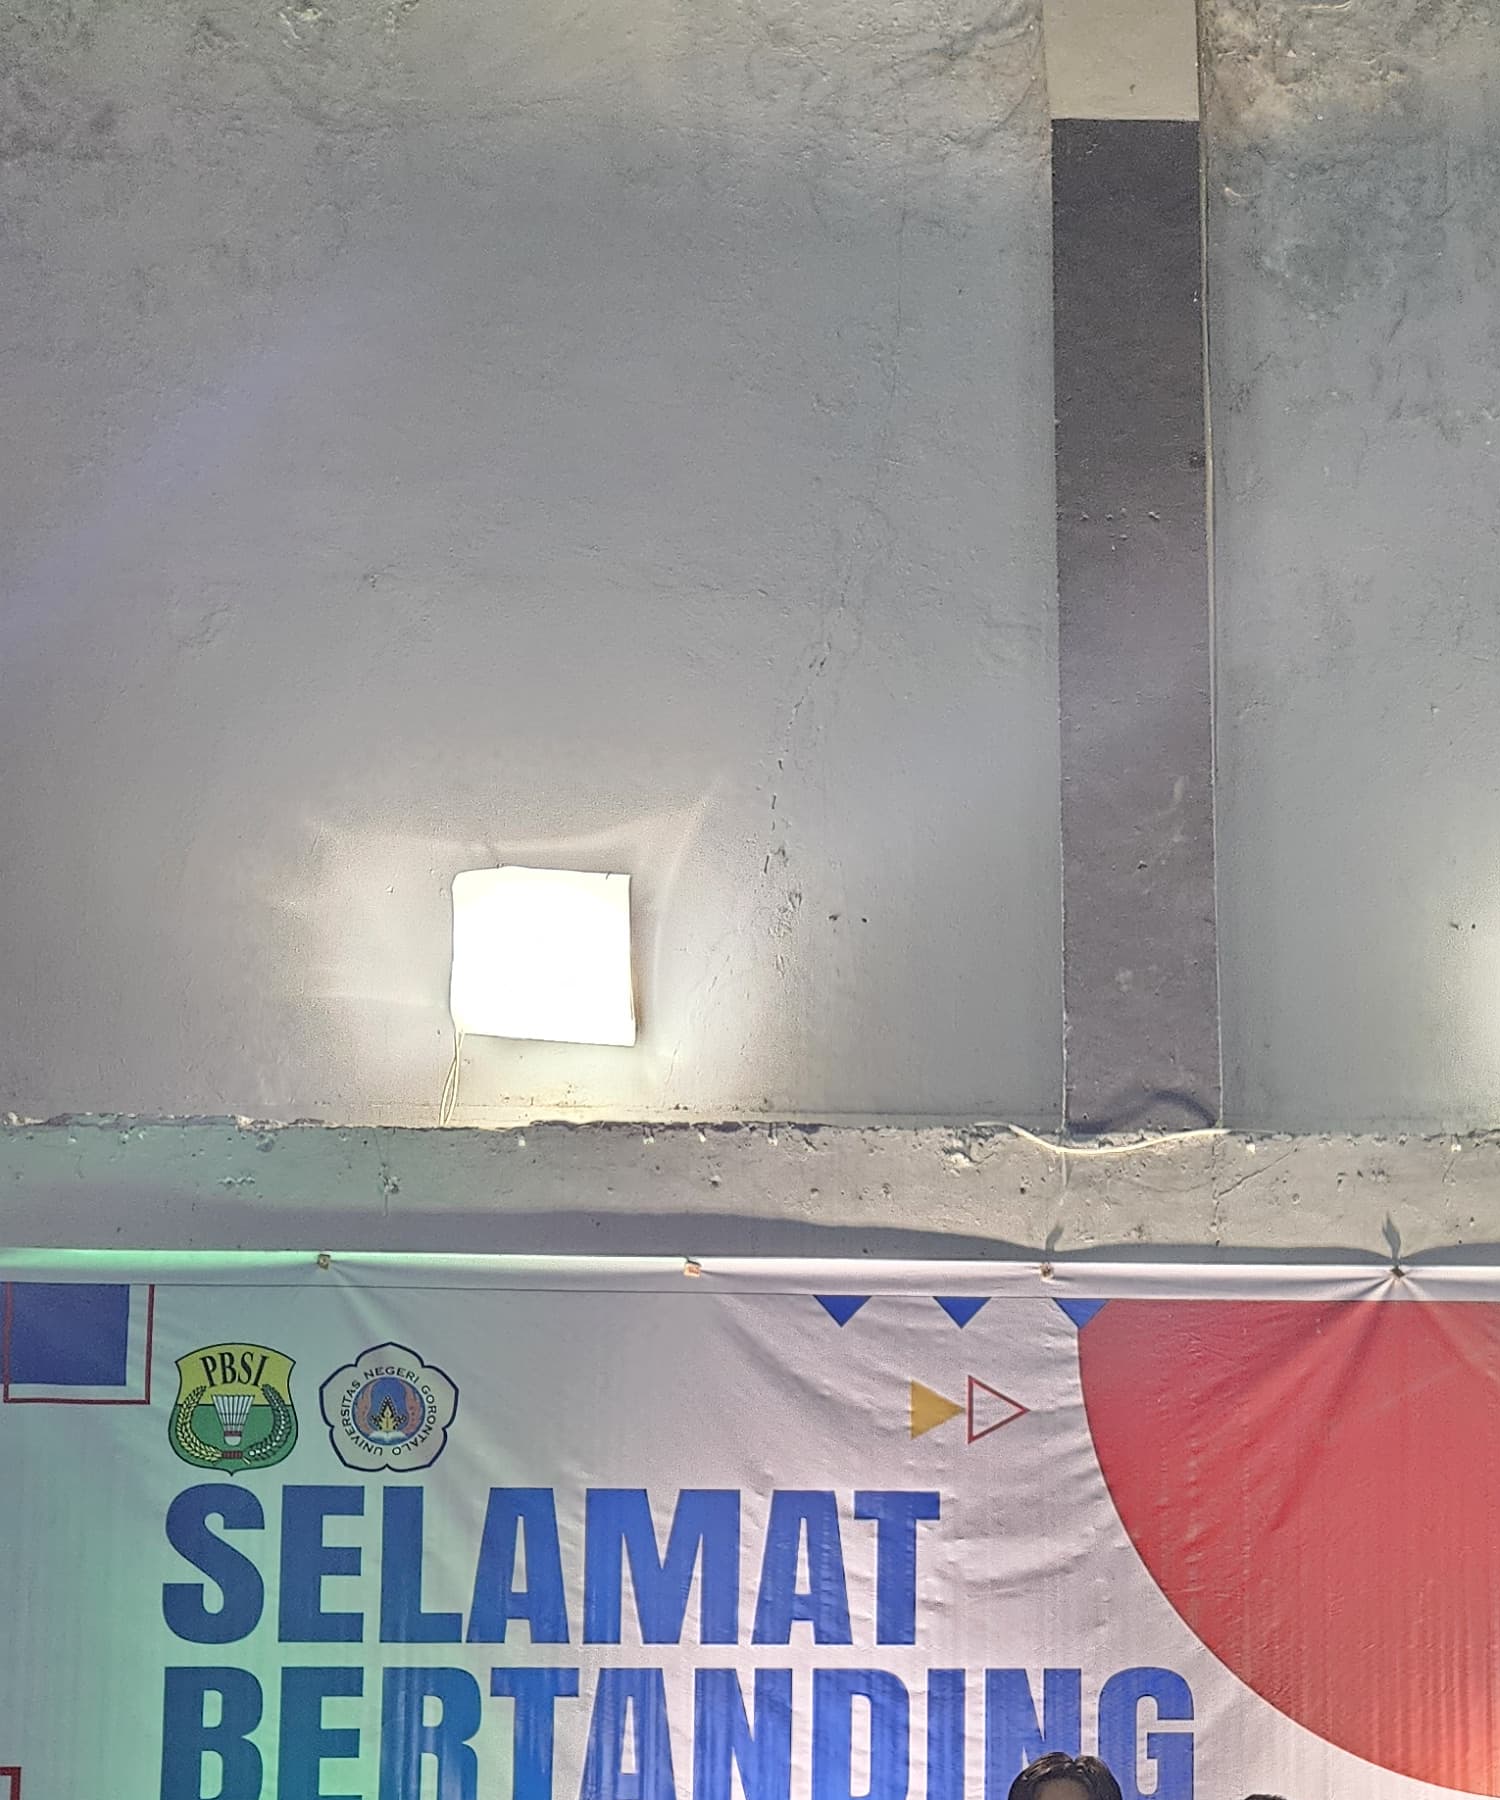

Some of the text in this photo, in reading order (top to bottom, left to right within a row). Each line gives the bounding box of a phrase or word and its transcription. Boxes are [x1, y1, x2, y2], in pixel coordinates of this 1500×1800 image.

[199, 1350, 270, 1387] PBSI
[341, 1366, 438, 1456] UNIVERSITAS NEGERI GORONTALO
[161, 1483, 941, 1645] SELAMAT
